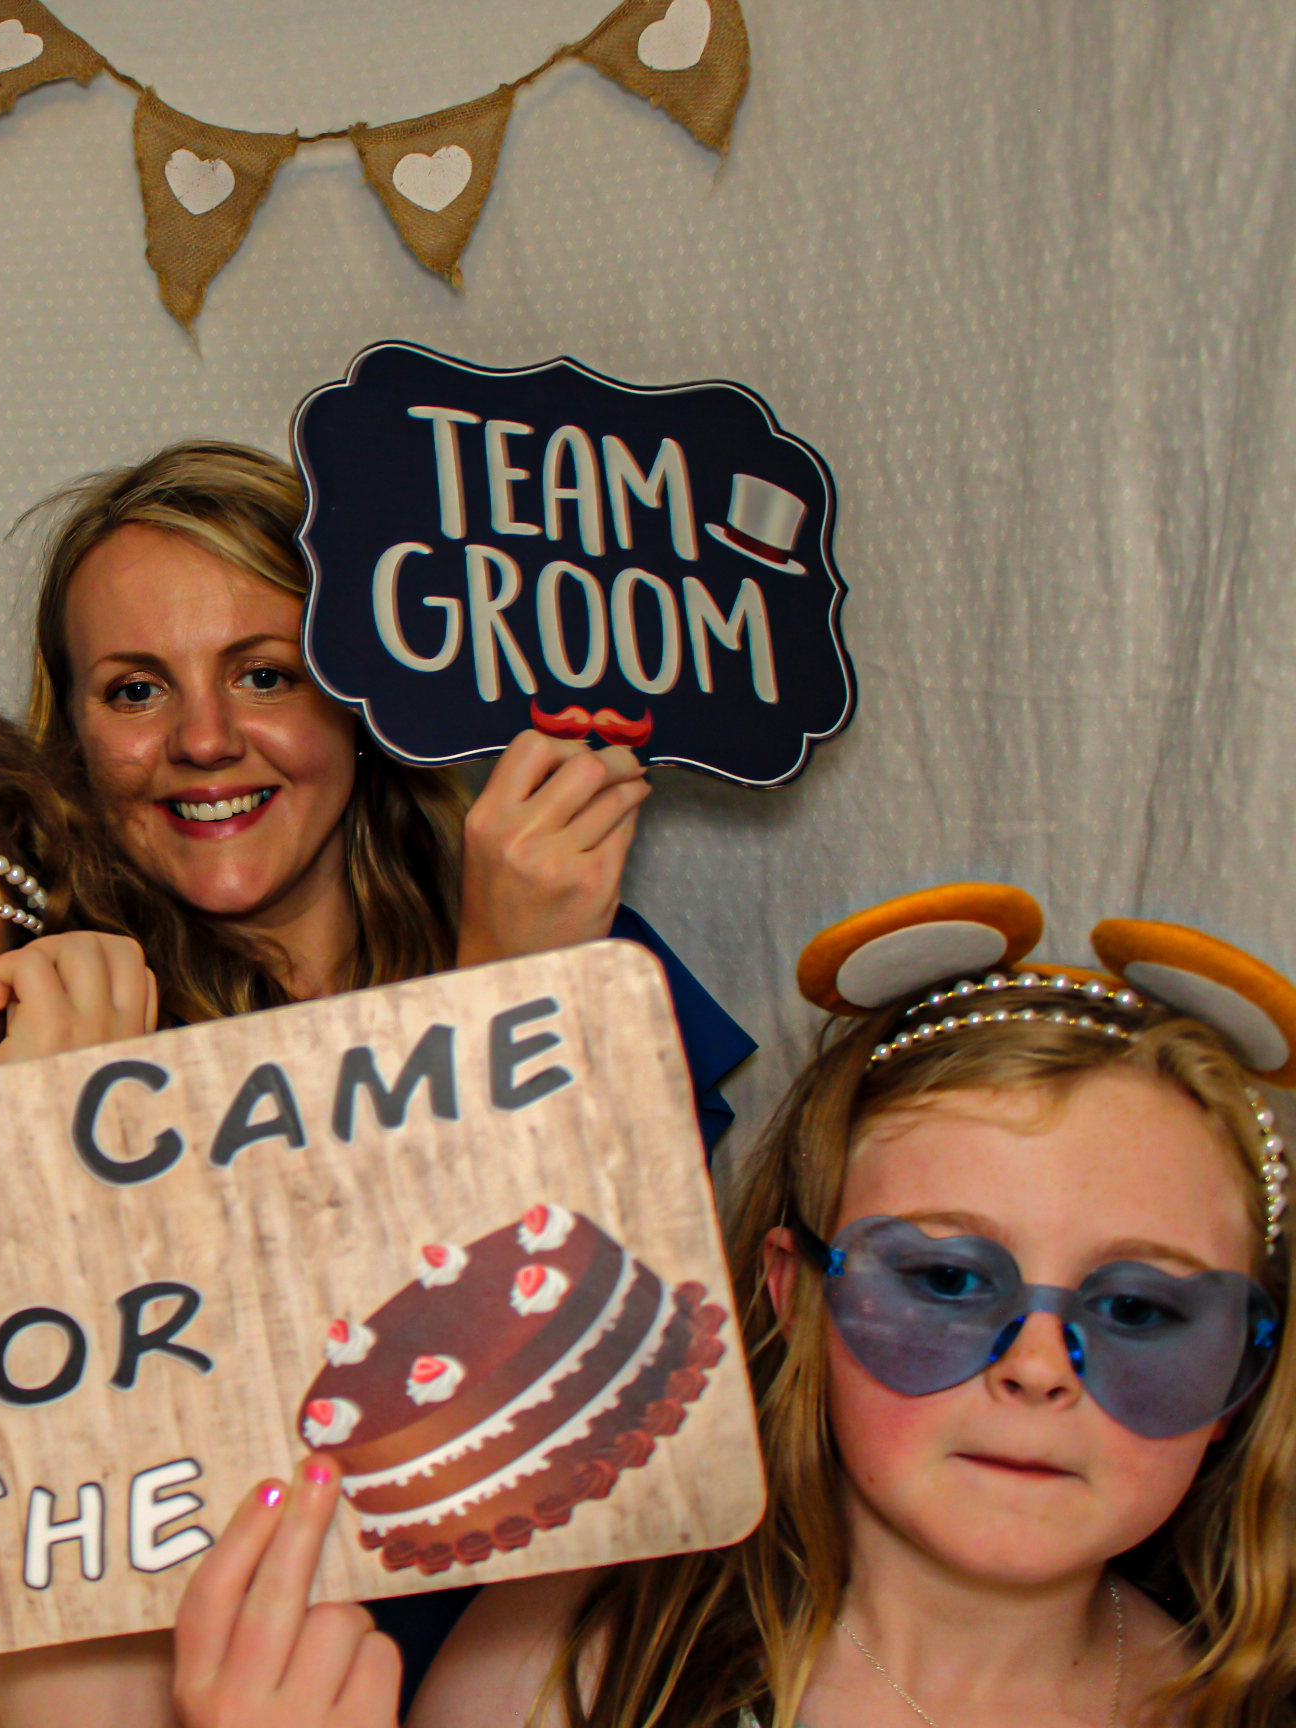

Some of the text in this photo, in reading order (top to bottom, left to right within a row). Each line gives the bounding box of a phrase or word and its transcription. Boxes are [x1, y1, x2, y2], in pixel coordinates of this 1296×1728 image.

[407, 406, 698, 561] TEAM
[372, 542, 777, 703] GROOM
[71, 996, 574, 1186] CAME
